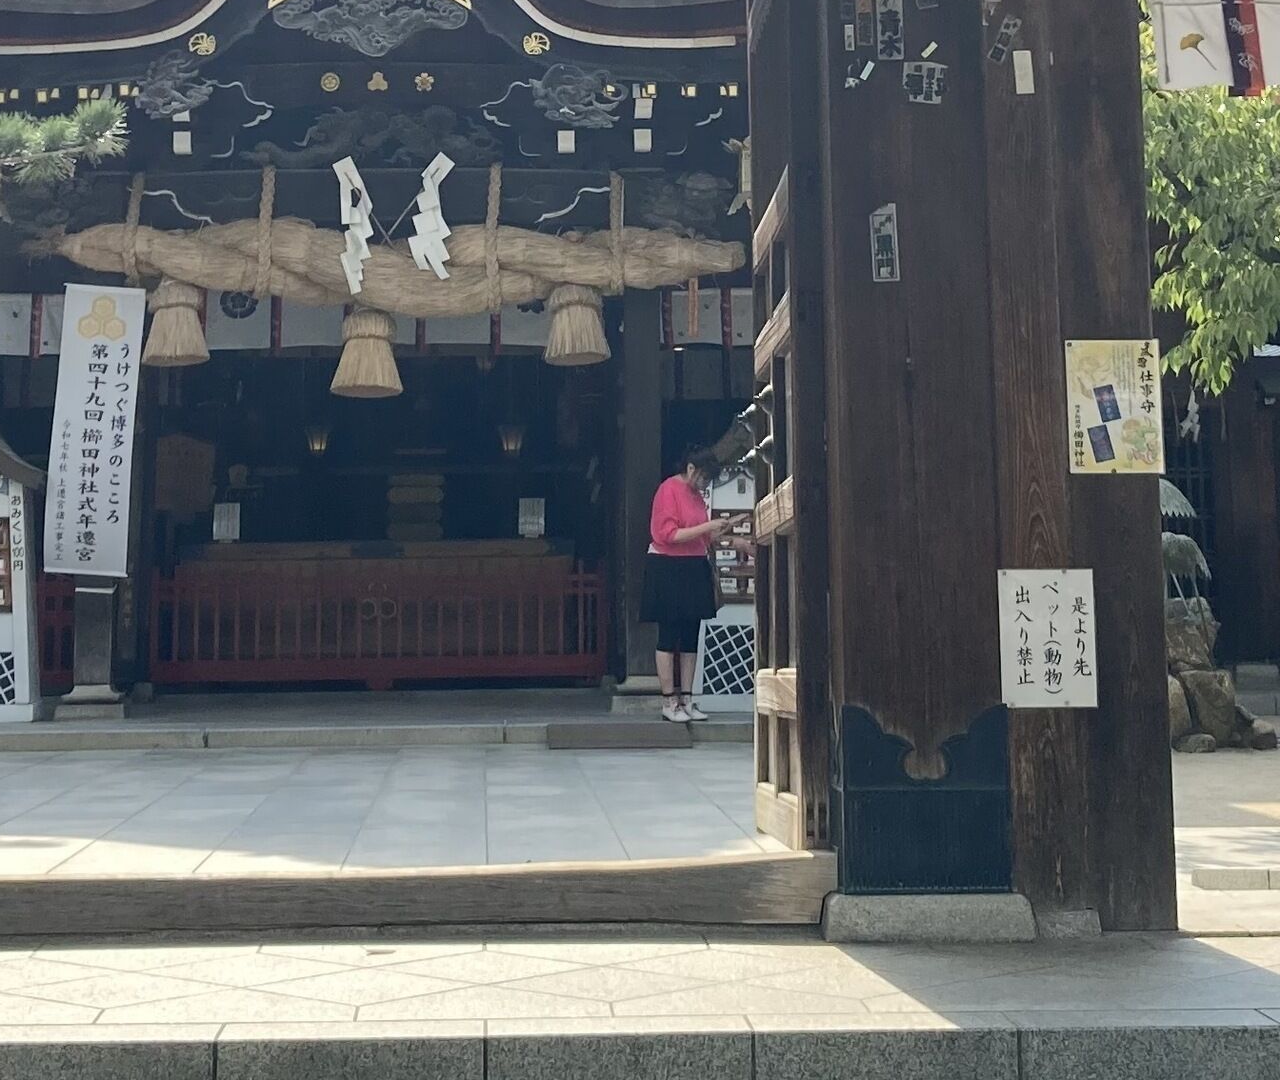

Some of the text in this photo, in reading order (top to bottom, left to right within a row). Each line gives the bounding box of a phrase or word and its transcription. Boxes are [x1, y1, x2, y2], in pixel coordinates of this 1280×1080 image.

[106, 343, 132, 524] うけつぐ博多のこころ
[1014, 585, 1035, 686] 出入り禁止
[1071, 596, 1093, 677] 是より先
